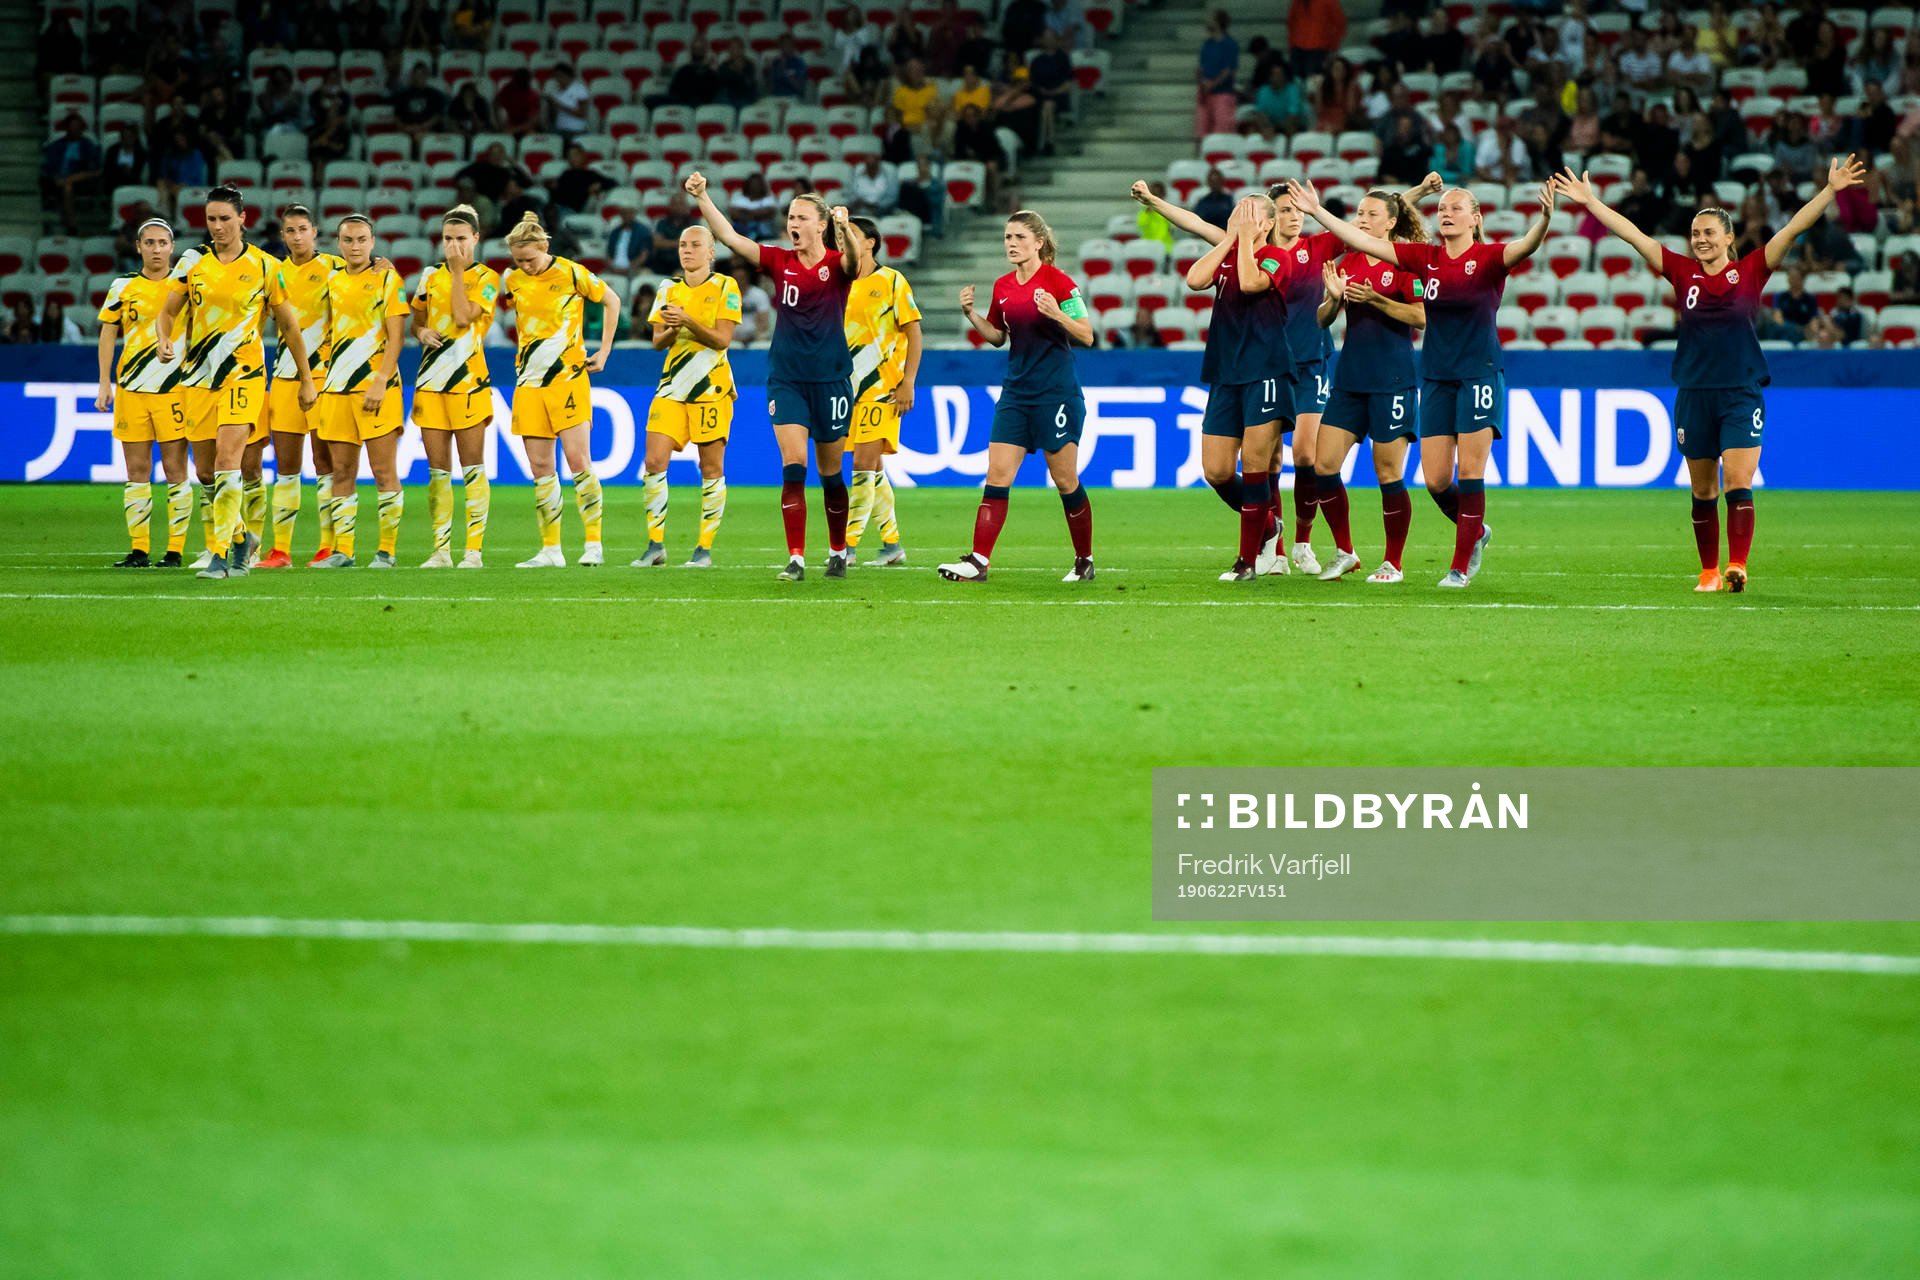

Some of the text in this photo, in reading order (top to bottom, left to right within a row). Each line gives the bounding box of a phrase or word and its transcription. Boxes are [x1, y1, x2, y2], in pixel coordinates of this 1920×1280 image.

[782, 280, 799, 307] 10
[1424, 278, 1440, 300] 18
[1686, 285, 1700, 309] 8
[129, 300, 138, 321] 5
[229, 387, 248, 409] 15
[564, 391, 576, 410] 4
[1263, 378, 1277, 403] 11
[1472, 384, 1493, 409] 18
[171, 402, 183, 424] 5
[700, 406, 718, 428] 13
[830, 396, 848, 420] 10
[859, 406, 882, 427] 20
[1055, 404, 1067, 428] 6
[1392, 395, 1404, 420] 5
[1752, 408, 1763, 430] 8
